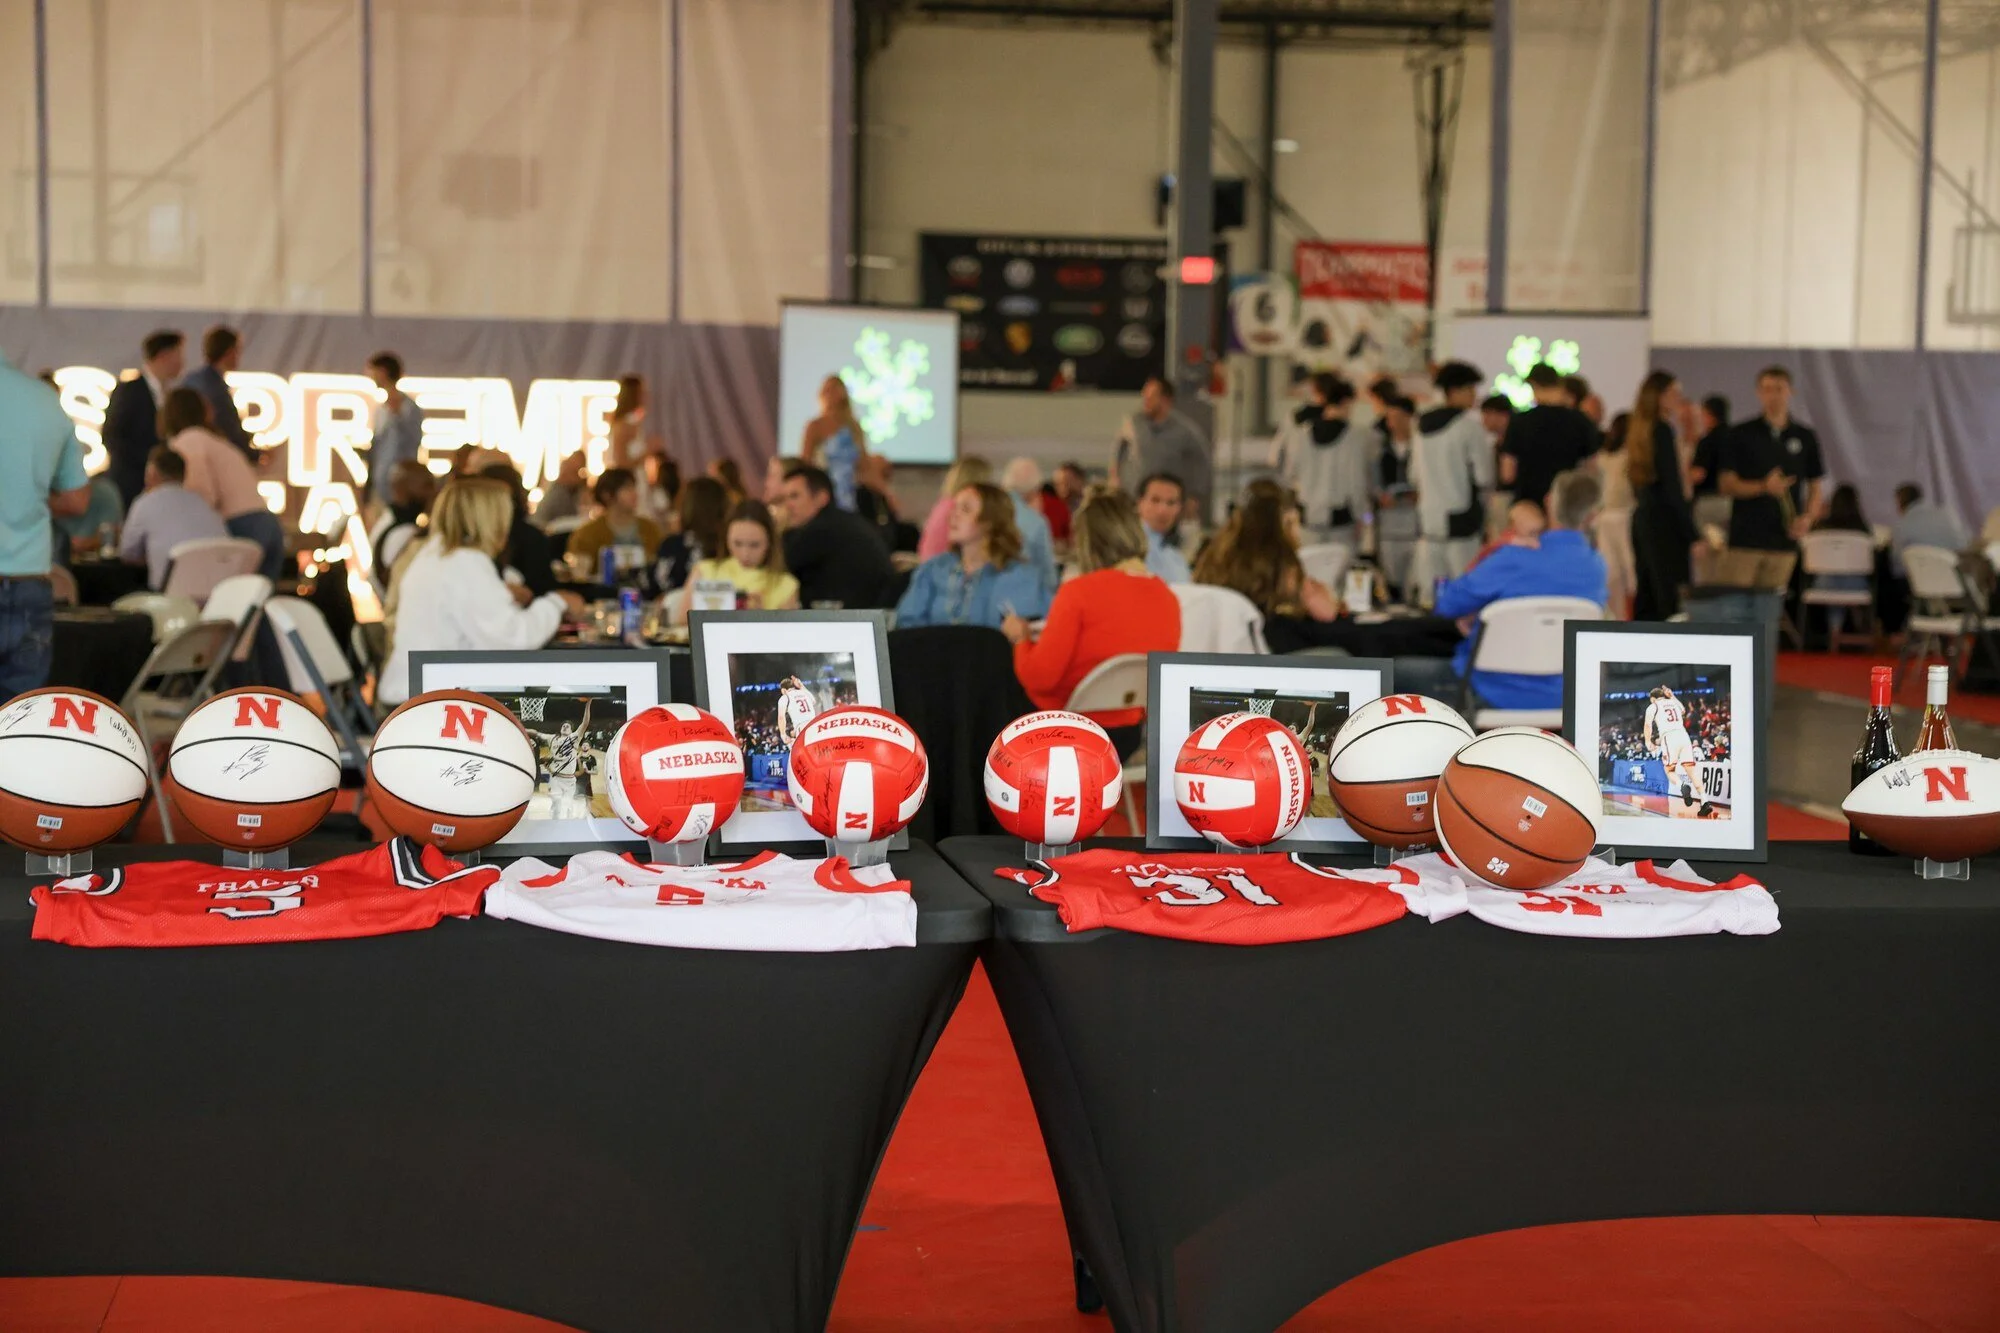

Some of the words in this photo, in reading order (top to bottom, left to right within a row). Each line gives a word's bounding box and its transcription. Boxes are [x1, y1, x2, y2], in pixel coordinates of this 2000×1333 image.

[49, 697, 99, 734] N
[235, 697, 281, 729] N
[1382, 694, 1426, 717] N
[1664, 708, 1679, 722] 31
[441, 705, 487, 743] N
[817, 717, 903, 737] NEBRASKA
[658, 752, 737, 770] NEBRASKA
[1188, 781, 1205, 803] N
[1280, 745, 1301, 828] NEBRASKA
[1923, 766, 1970, 802] N
[1053, 796, 1075, 816] N
[845, 812, 867, 829] N
